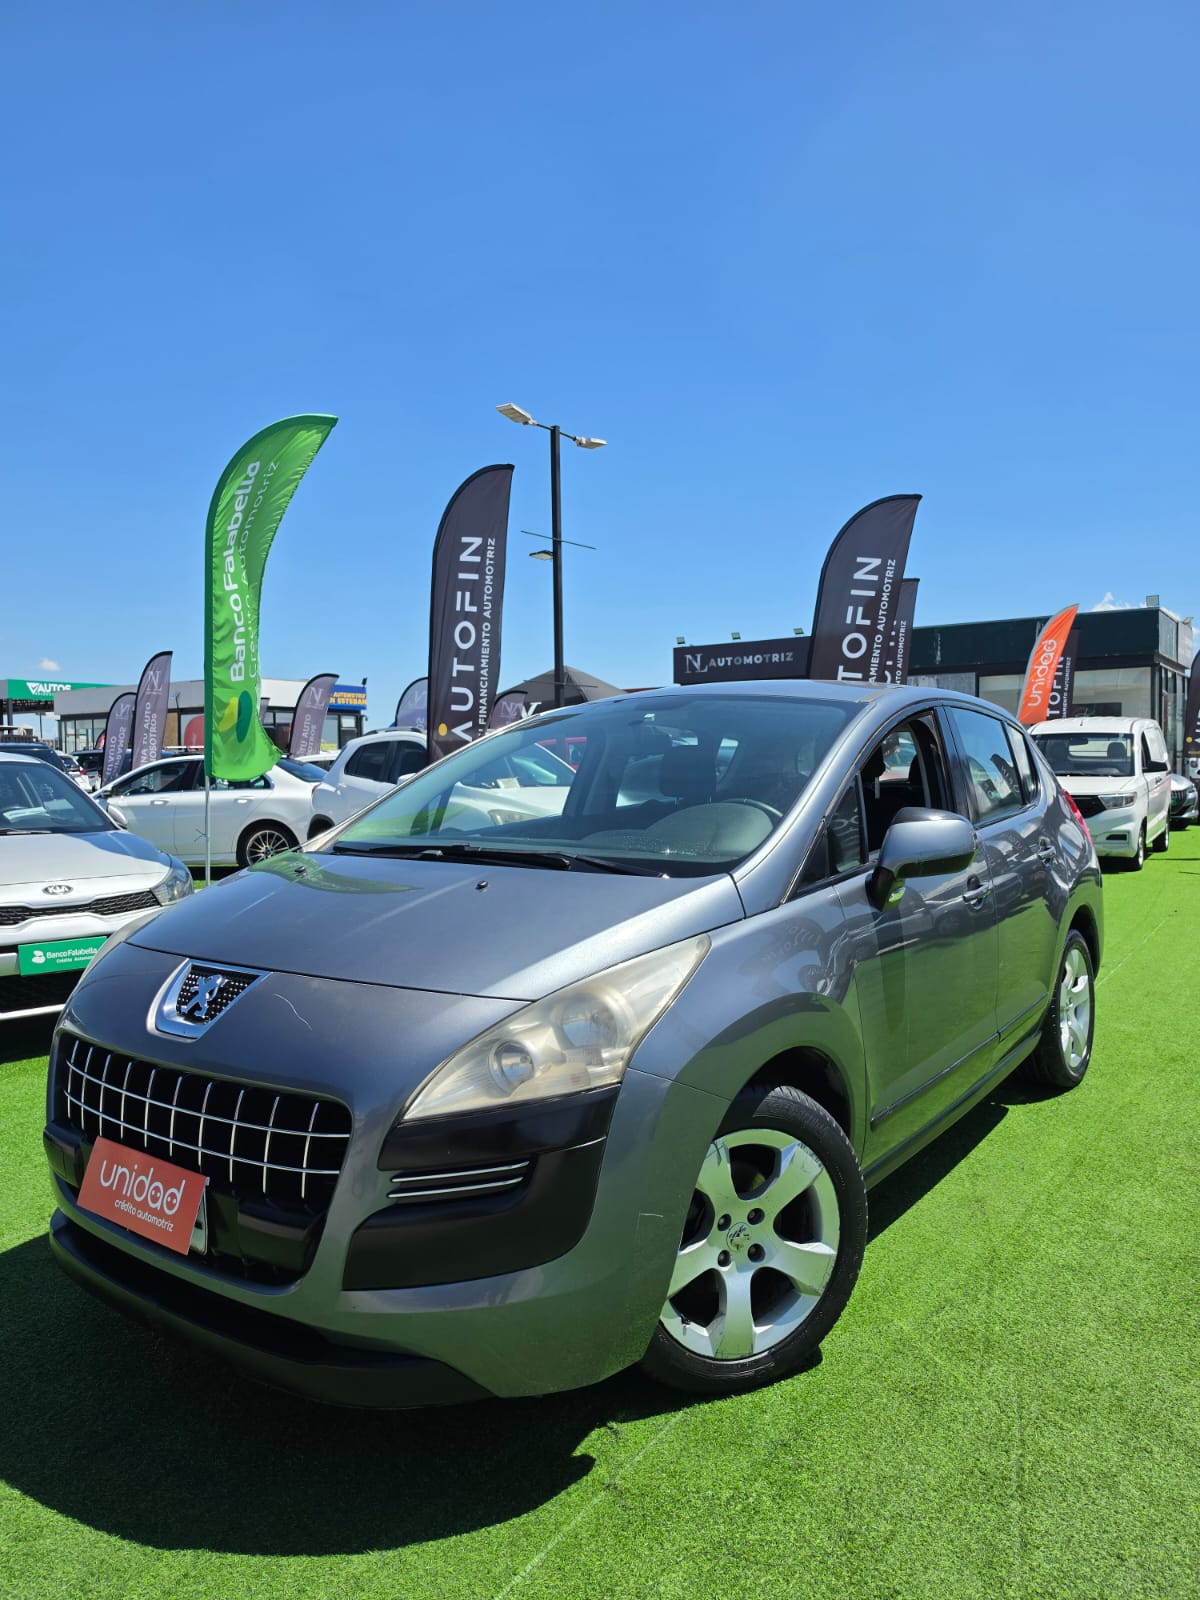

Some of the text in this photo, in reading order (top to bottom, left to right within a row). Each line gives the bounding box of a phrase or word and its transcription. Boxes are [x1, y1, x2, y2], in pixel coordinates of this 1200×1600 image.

[483, 537, 496, 618] AUTOMOTRIZ
[837, 556, 882, 681] TOFIN
[868, 633, 884, 685] AMIENTO
[877, 558, 896, 632] AUTOMOTRIZ
[896, 620, 907, 668] AUTOMOTRIZ
[478, 622, 492, 726] FINANCIAMIENTO
[708, 652, 794, 667] AUTOMOTRIZ
[1028, 639, 1057, 707] unidad
[143, 702, 151, 729] AUTO
[99, 1159, 186, 1215] unidad
[114, 1199, 175, 1233] crédito automotriz
